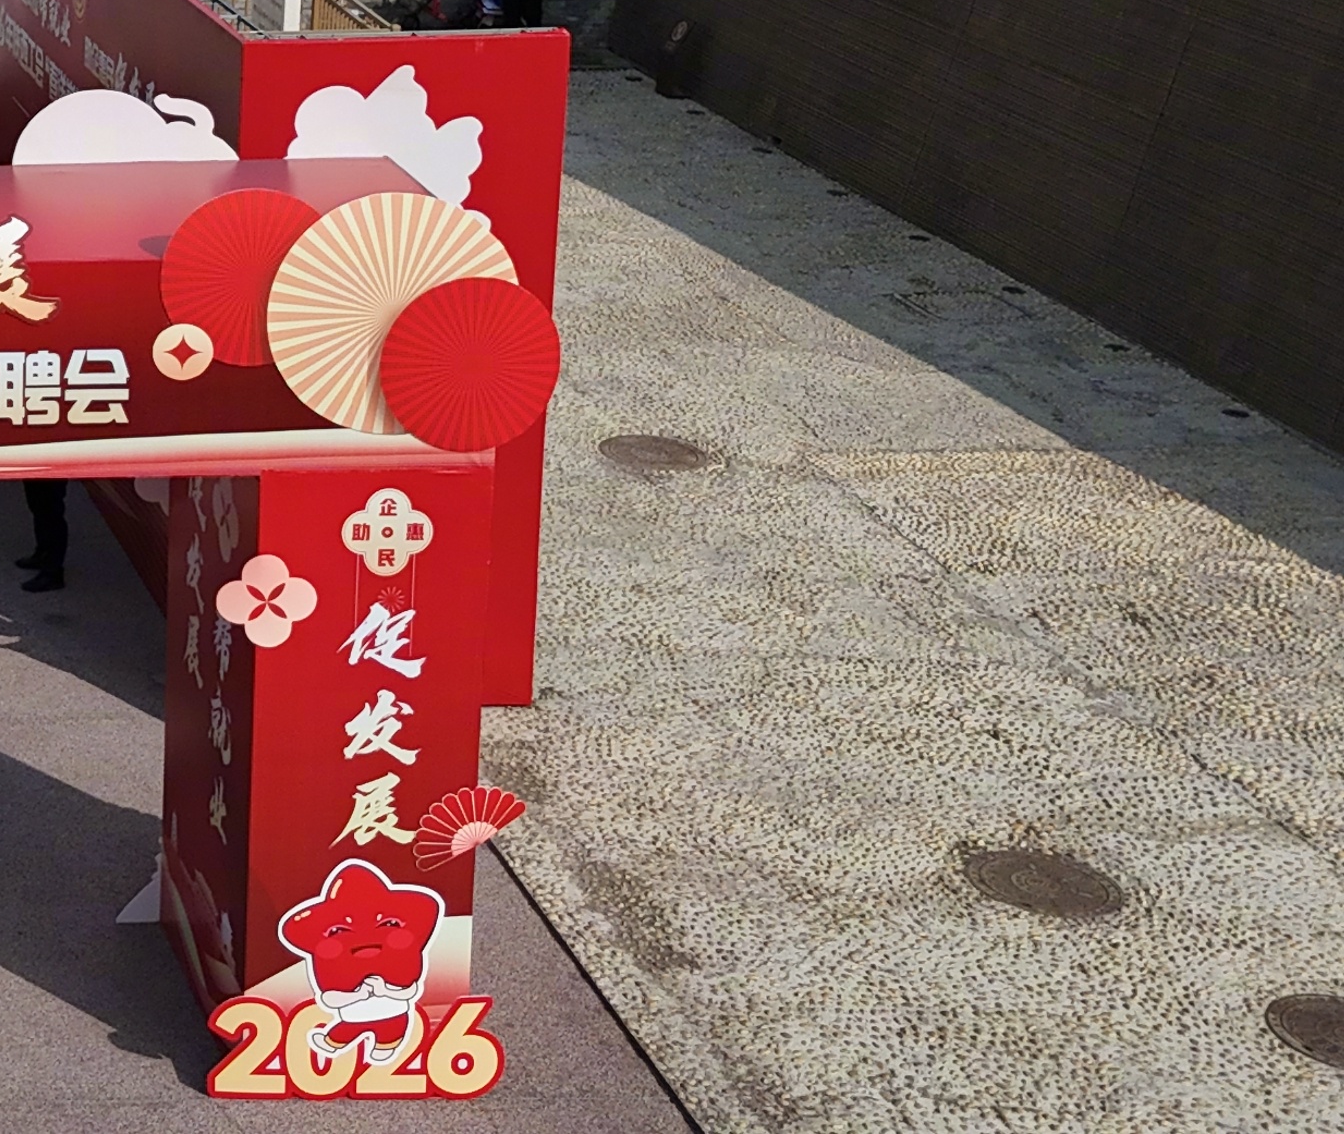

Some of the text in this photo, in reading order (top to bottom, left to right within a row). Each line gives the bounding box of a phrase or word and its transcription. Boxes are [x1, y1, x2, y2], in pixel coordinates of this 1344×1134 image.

[330, 602, 426, 850] 促发展
[214, 1002, 499, 1097] 2026
